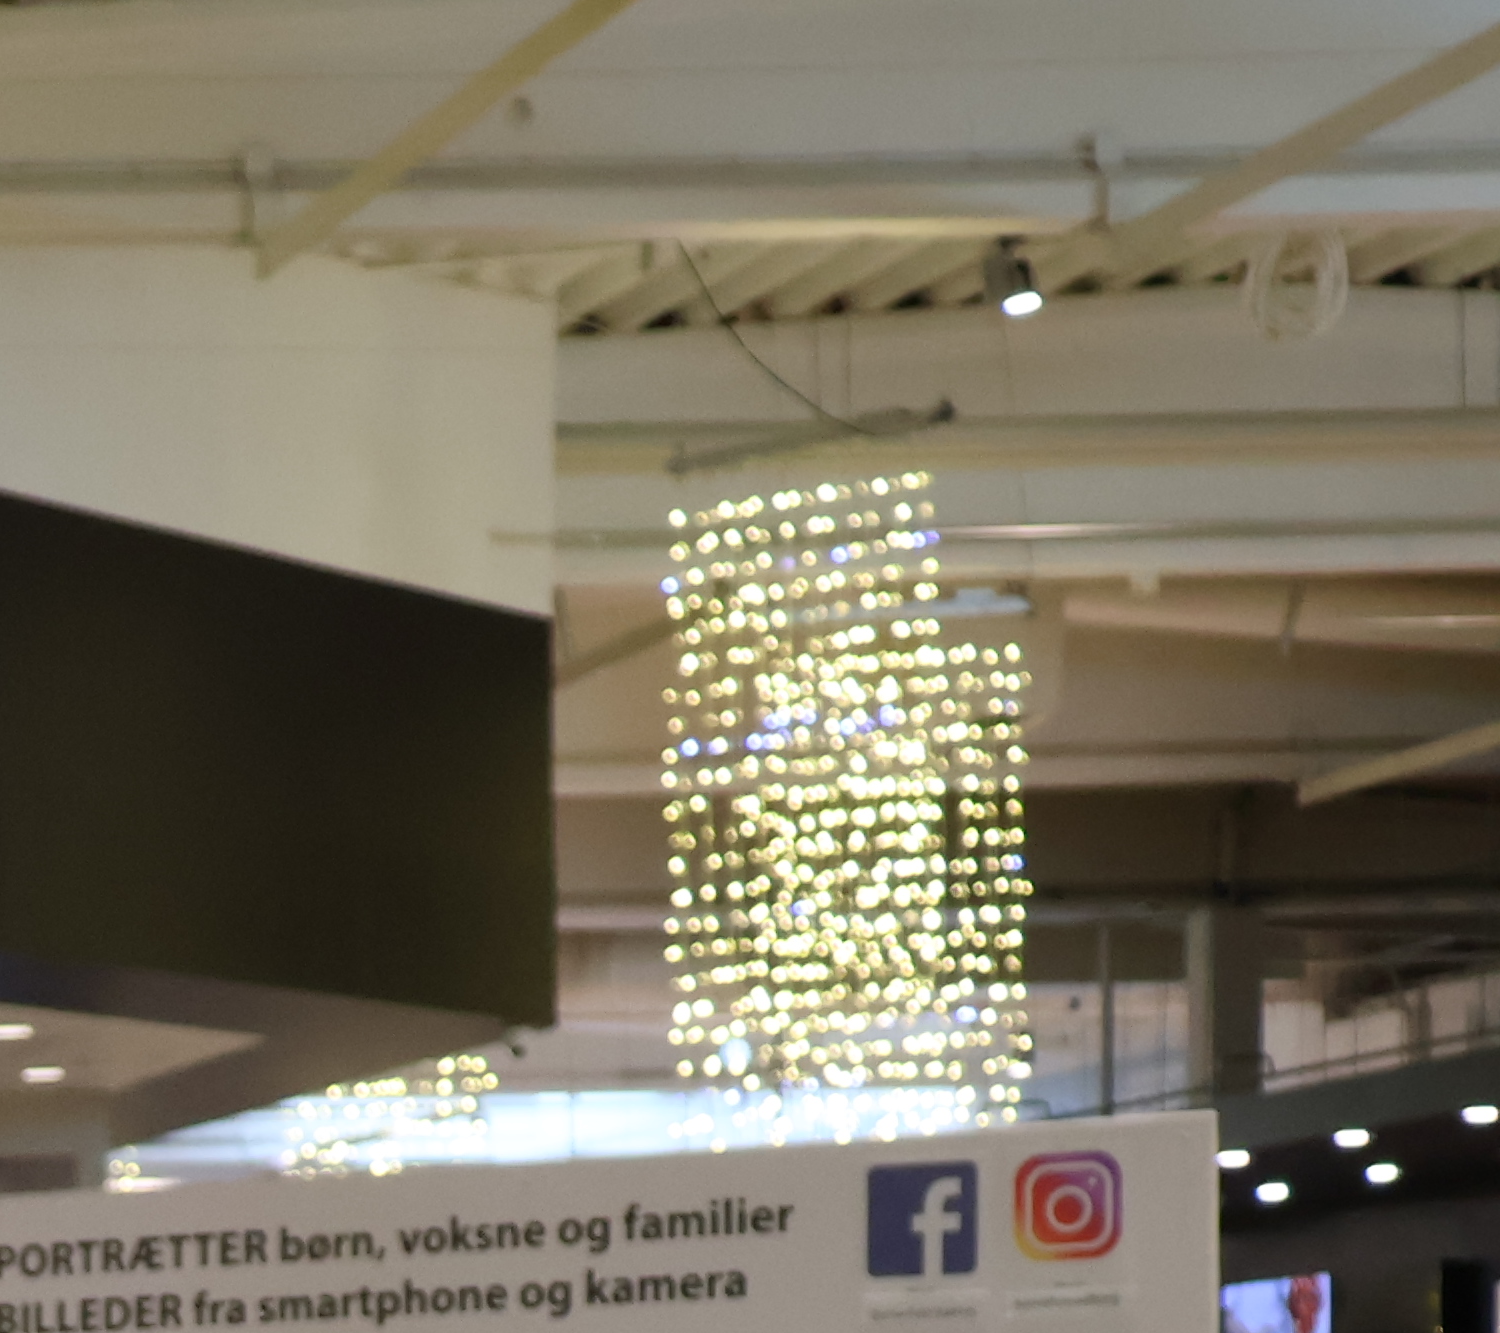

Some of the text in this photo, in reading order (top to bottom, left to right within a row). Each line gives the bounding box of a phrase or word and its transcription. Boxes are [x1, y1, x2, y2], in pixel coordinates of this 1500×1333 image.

[279, 1226, 386, 1263] børn,
[400, 1215, 547, 1255] voksne
[558, 1215, 611, 1254] og
[623, 1197, 795, 1241] familier
[193, 1290, 247, 1325] fra
[257, 1279, 508, 1328] smartphone
[519, 1280, 573, 1318] og
[585, 1267, 748, 1305] kamera
